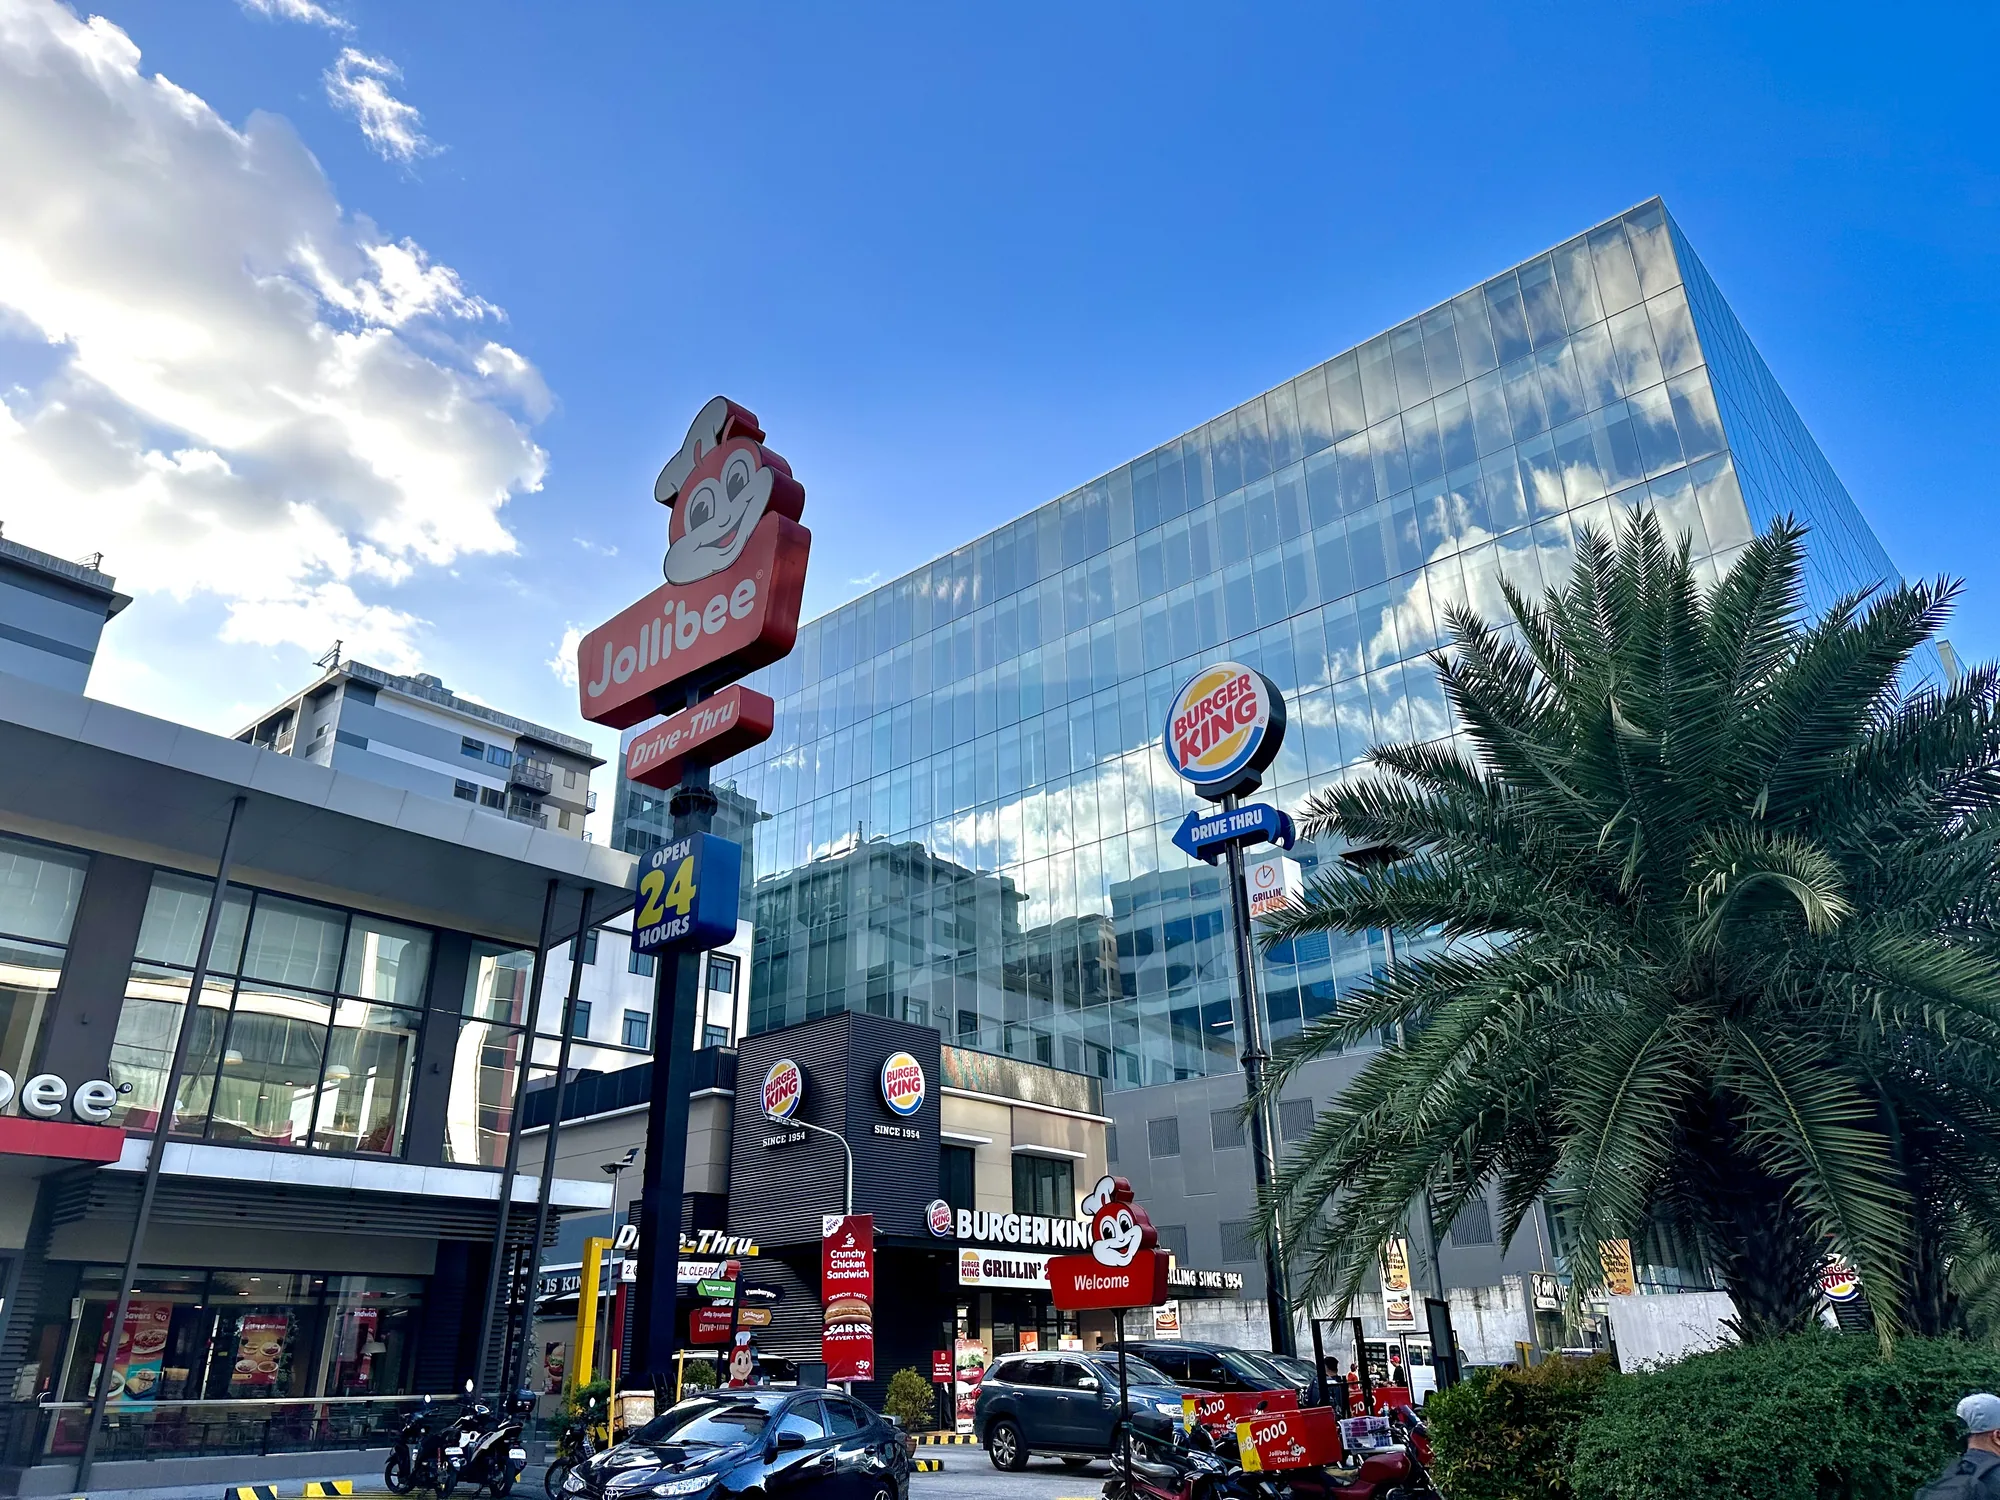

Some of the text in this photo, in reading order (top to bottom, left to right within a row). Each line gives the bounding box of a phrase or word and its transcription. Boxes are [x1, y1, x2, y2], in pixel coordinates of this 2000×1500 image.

[588, 579, 757, 698] Jollibee
[1174, 673, 1252, 742] BURGER
[631, 700, 735, 770] Drive-Thru
[1179, 692, 1257, 768] KING
[1191, 808, 1263, 842] DRIVE THRU
[652, 838, 691, 868] OPEN
[637, 855, 697, 929] 24
[1252, 887, 1283, 903] GRILLIN'
[1251, 901, 1265, 915] 24
[638, 914, 690, 948] HOURS
[765, 1067, 797, 1095] BURGER
[886, 1066, 920, 1084] BURGER
[766, 1077, 798, 1112] KING
[887, 1077, 921, 1100] KING
[762, 1131, 806, 1147] SINCE 1954
[874, 1124, 920, 1139] SINCE 1954
[931, 1207, 949, 1219] BURGER
[932, 1213, 950, 1228] KING
[957, 1208, 1047, 1246] BURGER
[830, 1249, 866, 1260] Crunchy
[831, 1260, 866, 1269] Chicken
[961, 1260, 980, 1268] BURGER
[961, 1267, 980, 1277] KING
[982, 1258, 1042, 1280] GRILLIN'
[826, 1269, 870, 1280] Sandwich
[1074, 1274, 1130, 1291] Welcome
[1198, 1271, 1222, 1288] SINCE
[1223, 1272, 1243, 1289] 1954
[545, 1278, 558, 1293] IS
